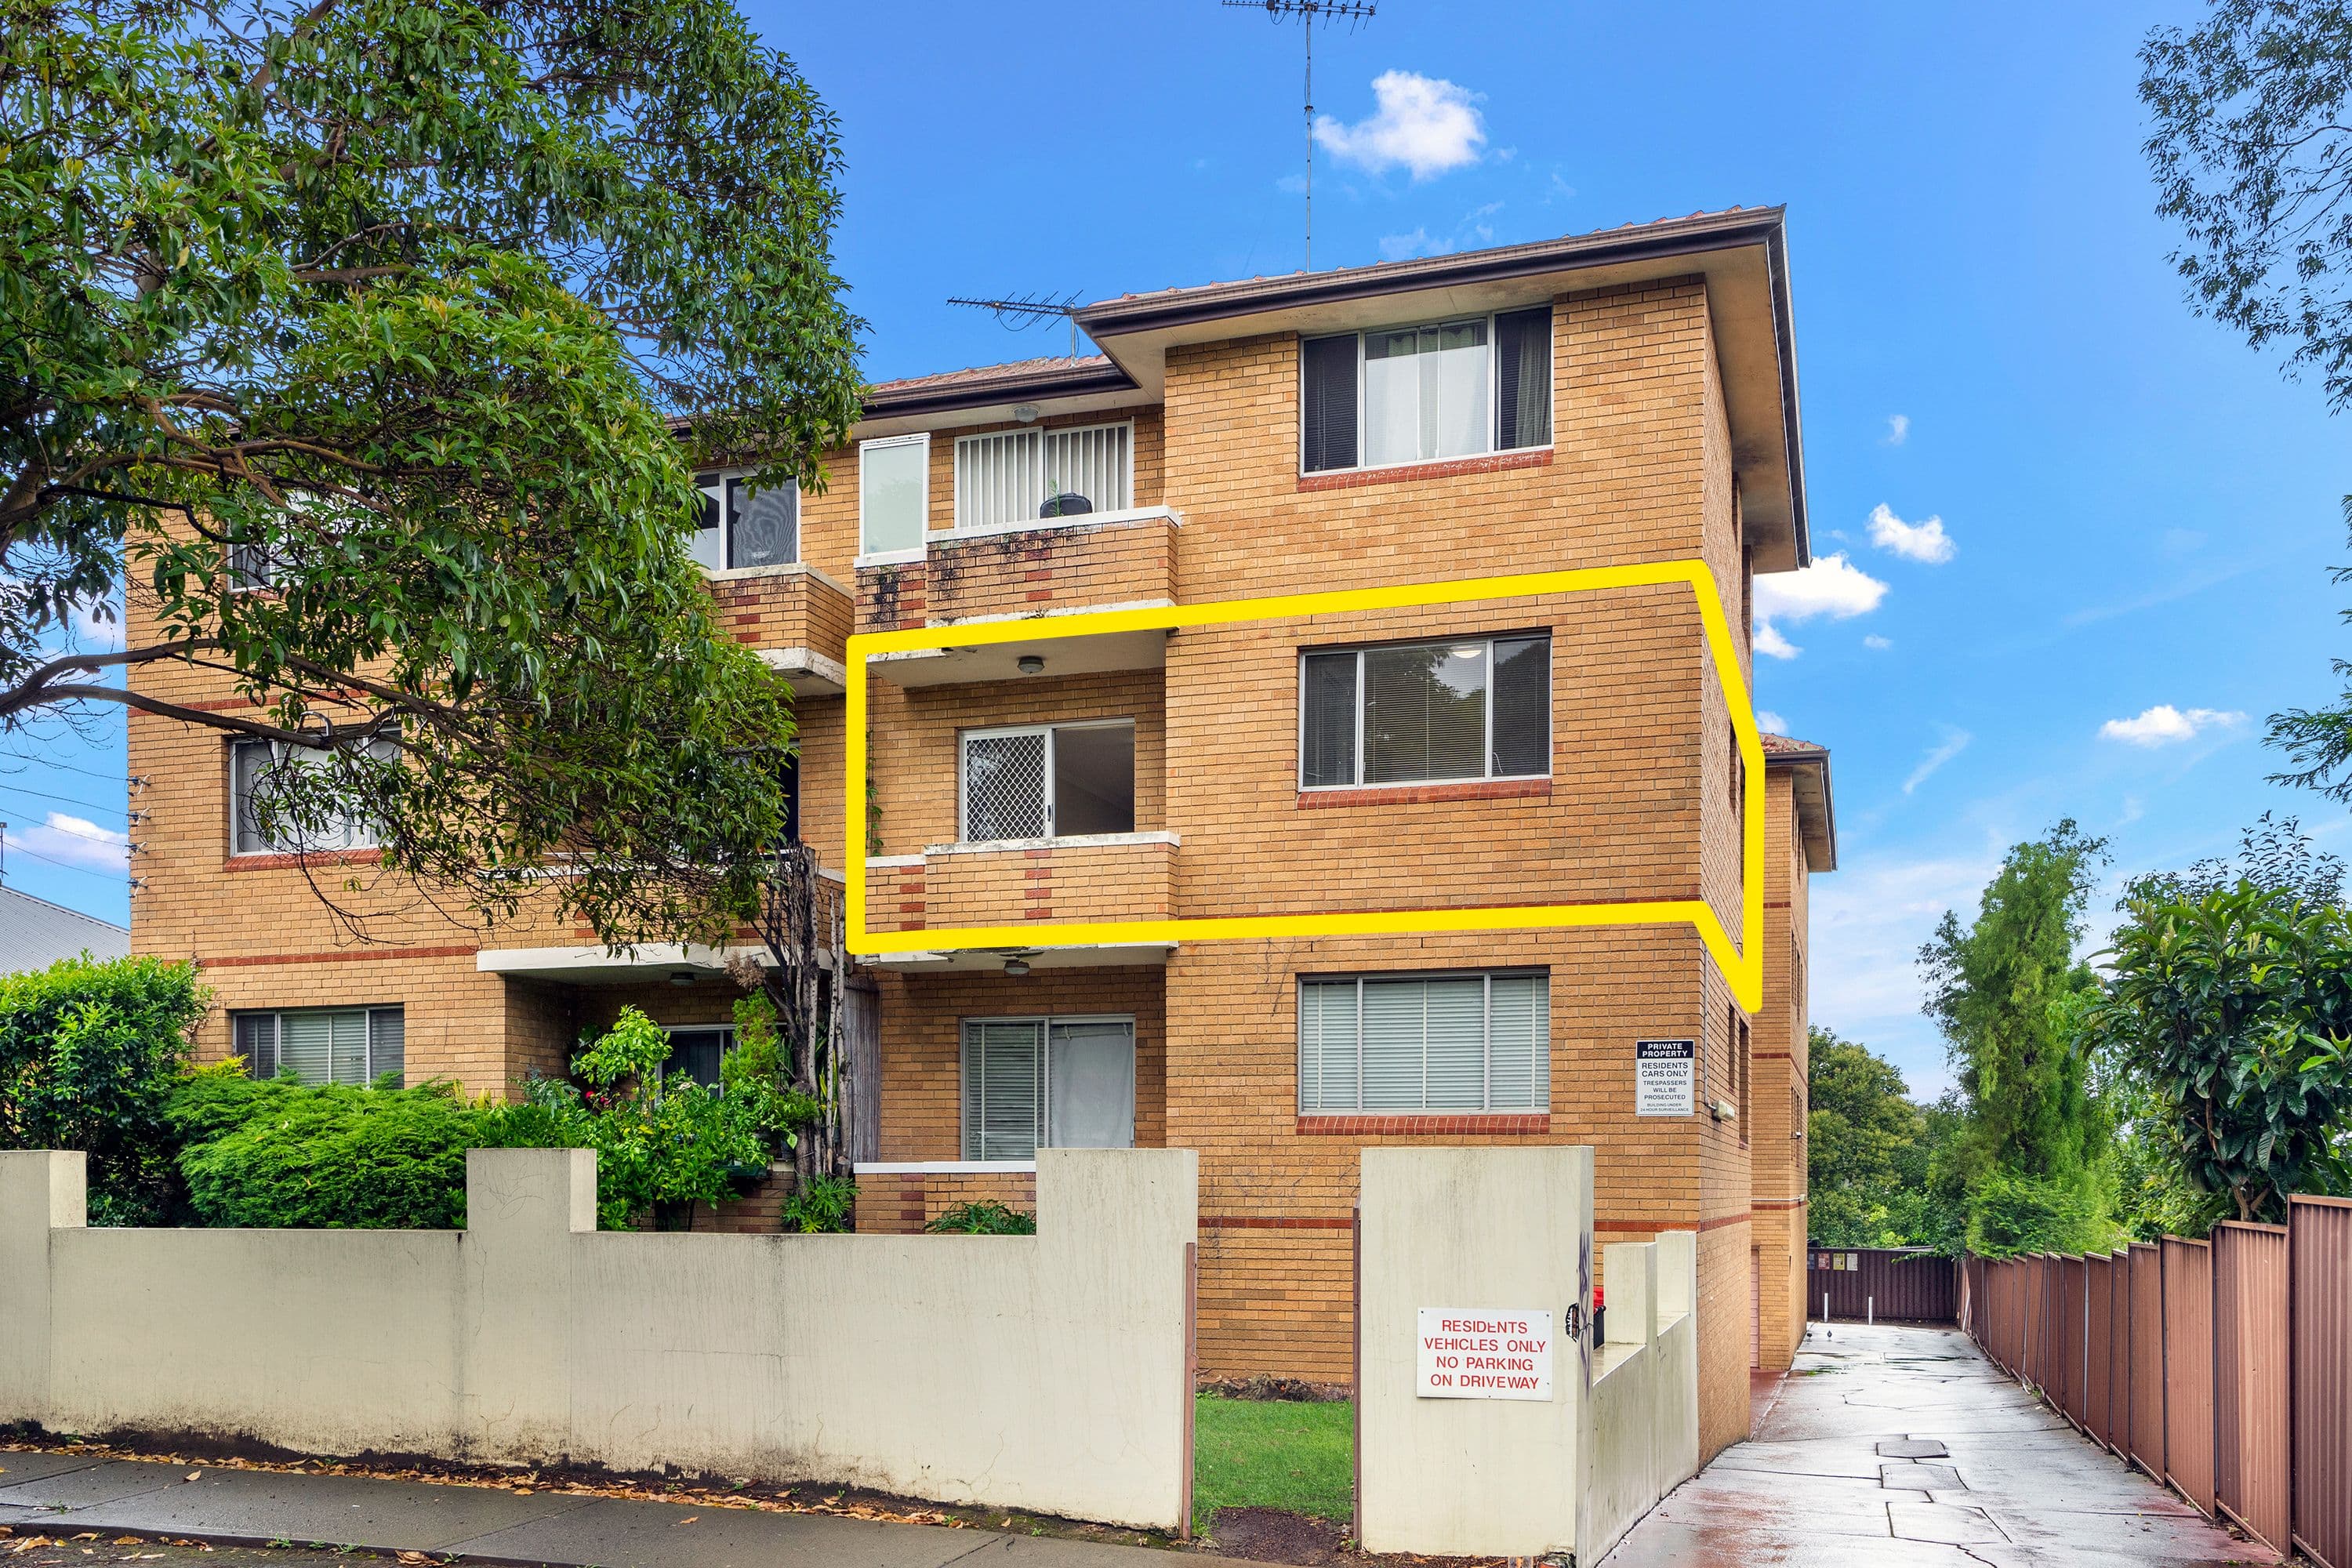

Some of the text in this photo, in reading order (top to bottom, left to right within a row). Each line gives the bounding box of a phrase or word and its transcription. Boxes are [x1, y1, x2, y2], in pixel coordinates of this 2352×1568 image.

[1442, 1319, 1527, 1334] RESIDENTS
[1424, 1338, 1546, 1353] VEHICLES ONLY
[1436, 1356, 1534, 1370] NO PARKING
[1430, 1374, 1539, 1389] ON DRIVEWAY
